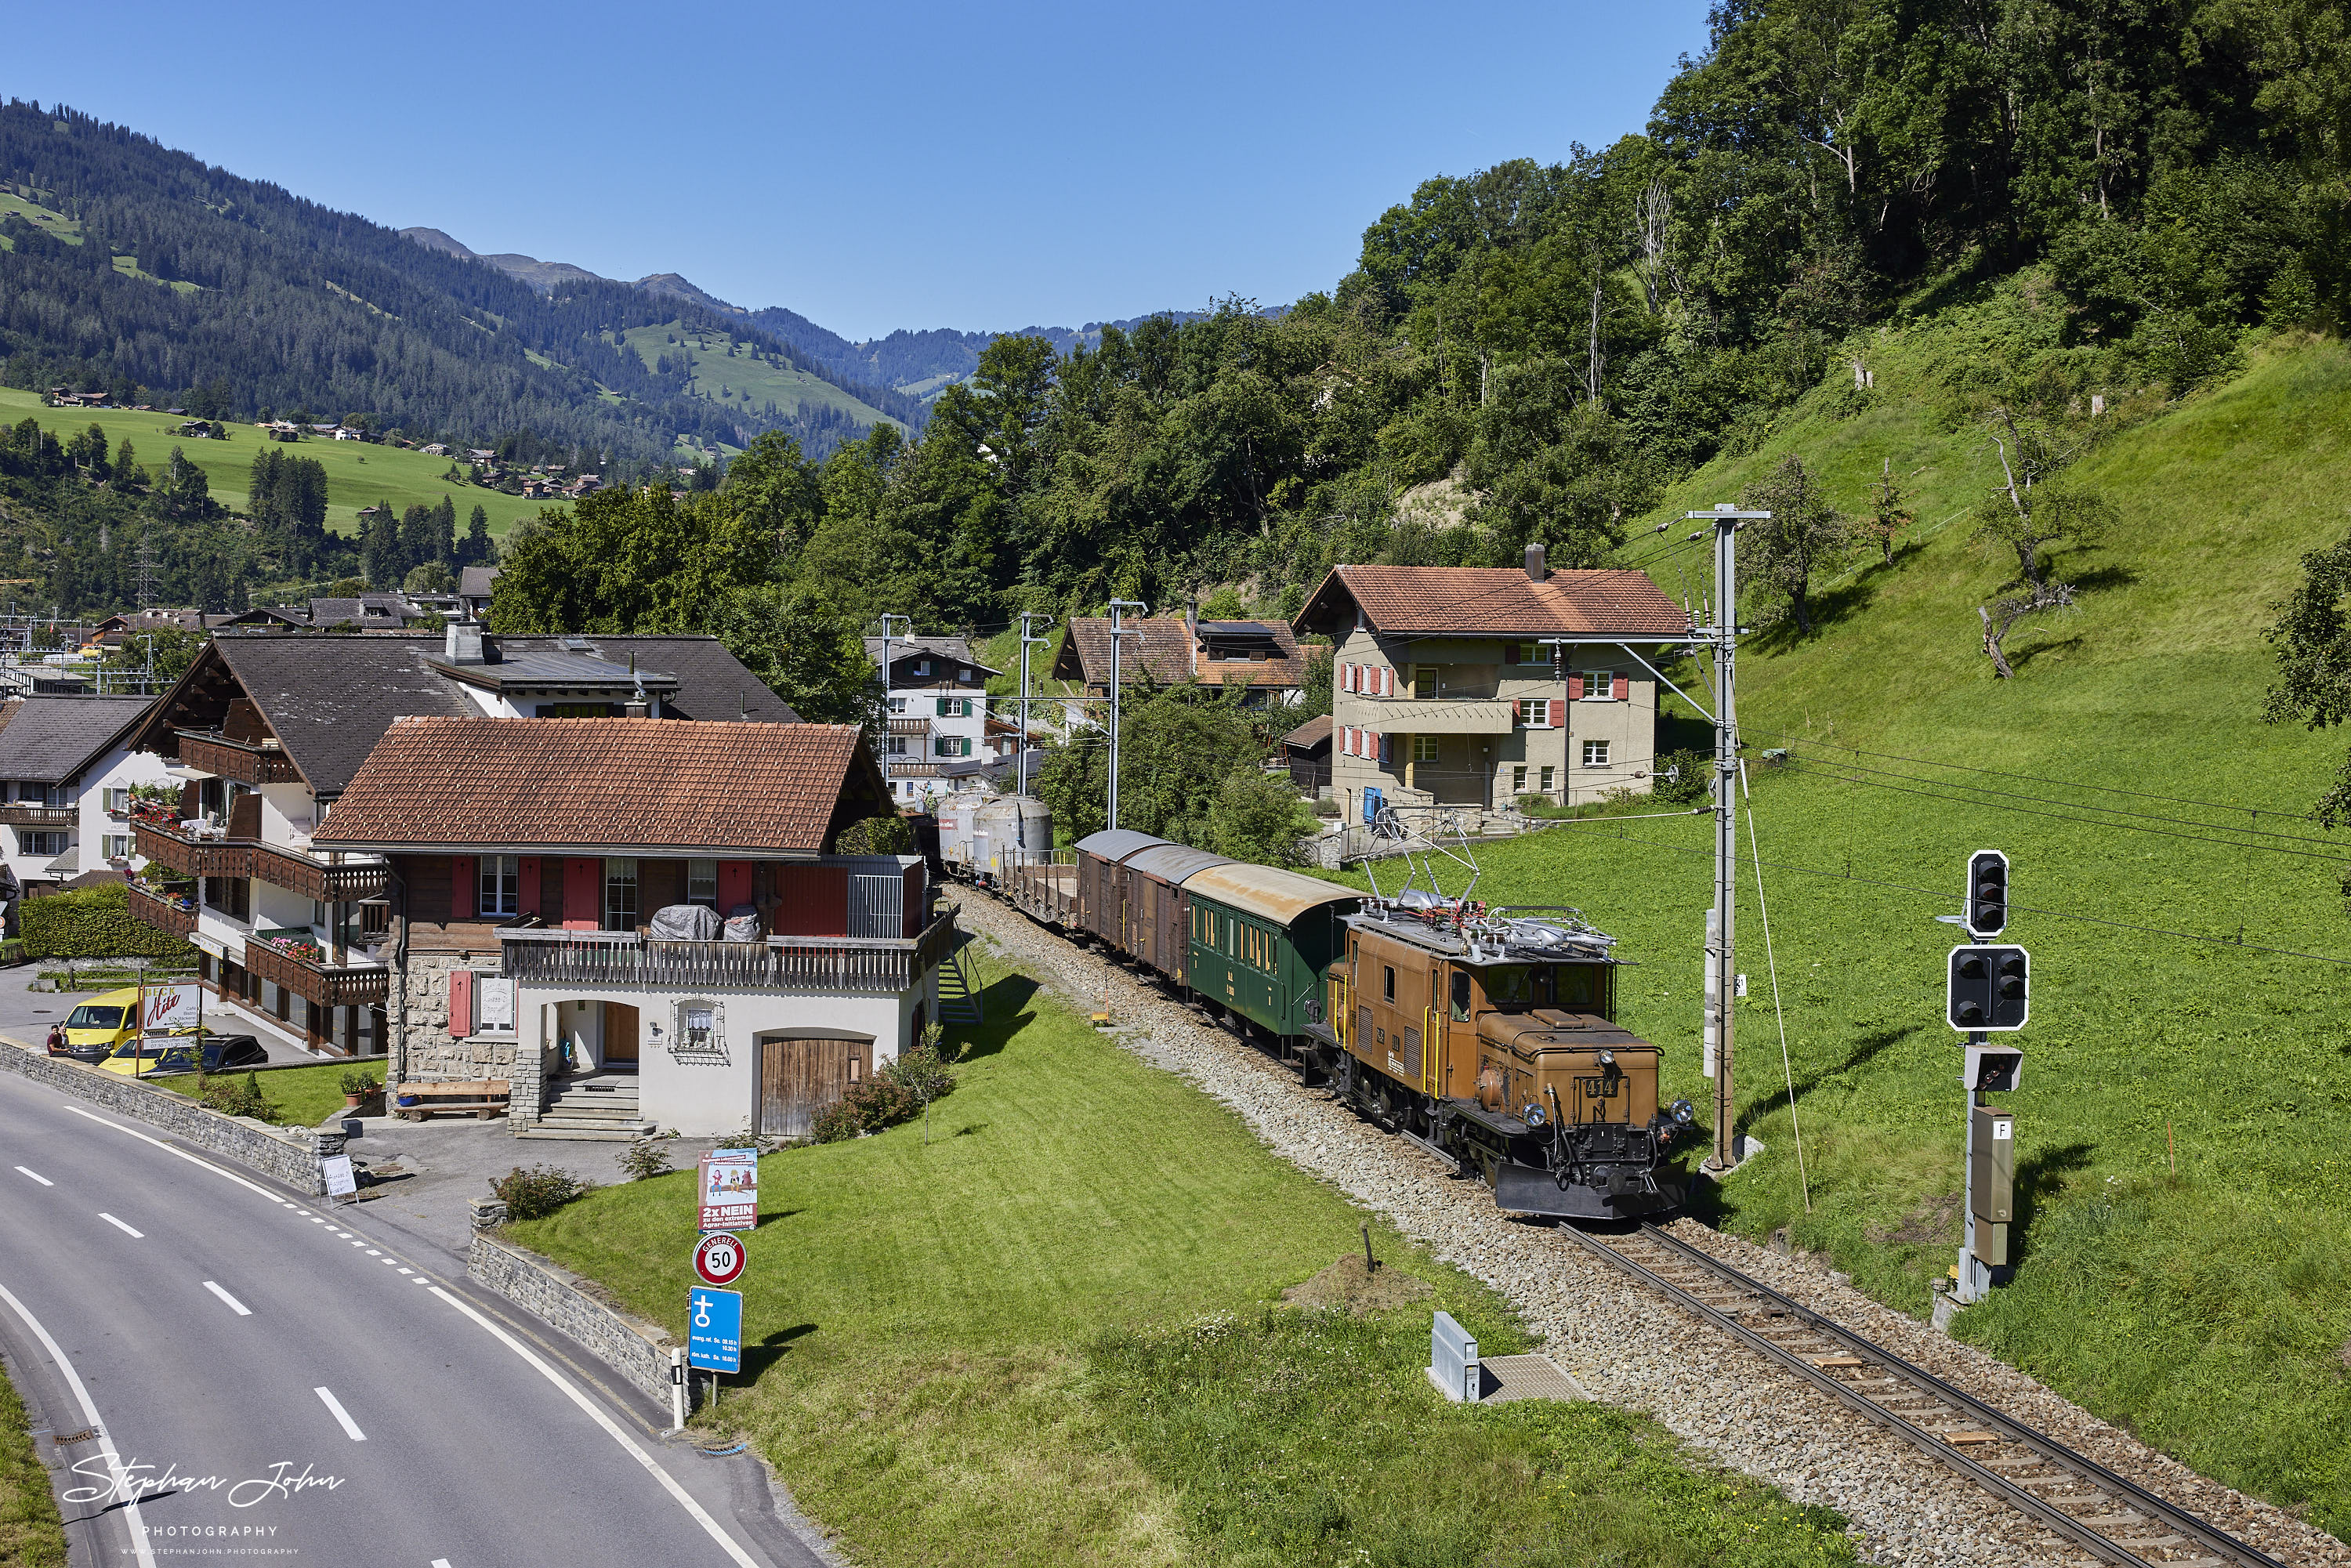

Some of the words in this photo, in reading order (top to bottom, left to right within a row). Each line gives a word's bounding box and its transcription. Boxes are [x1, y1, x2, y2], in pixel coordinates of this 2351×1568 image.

[146, 987, 176, 997] BECK
[1587, 1080, 1614, 1095] 414
[2000, 1124, 2005, 1136] F
[721, 1204, 753, 1216] NEIN
[703, 1237, 738, 1252] GENERELL
[712, 1251, 730, 1269] 50
